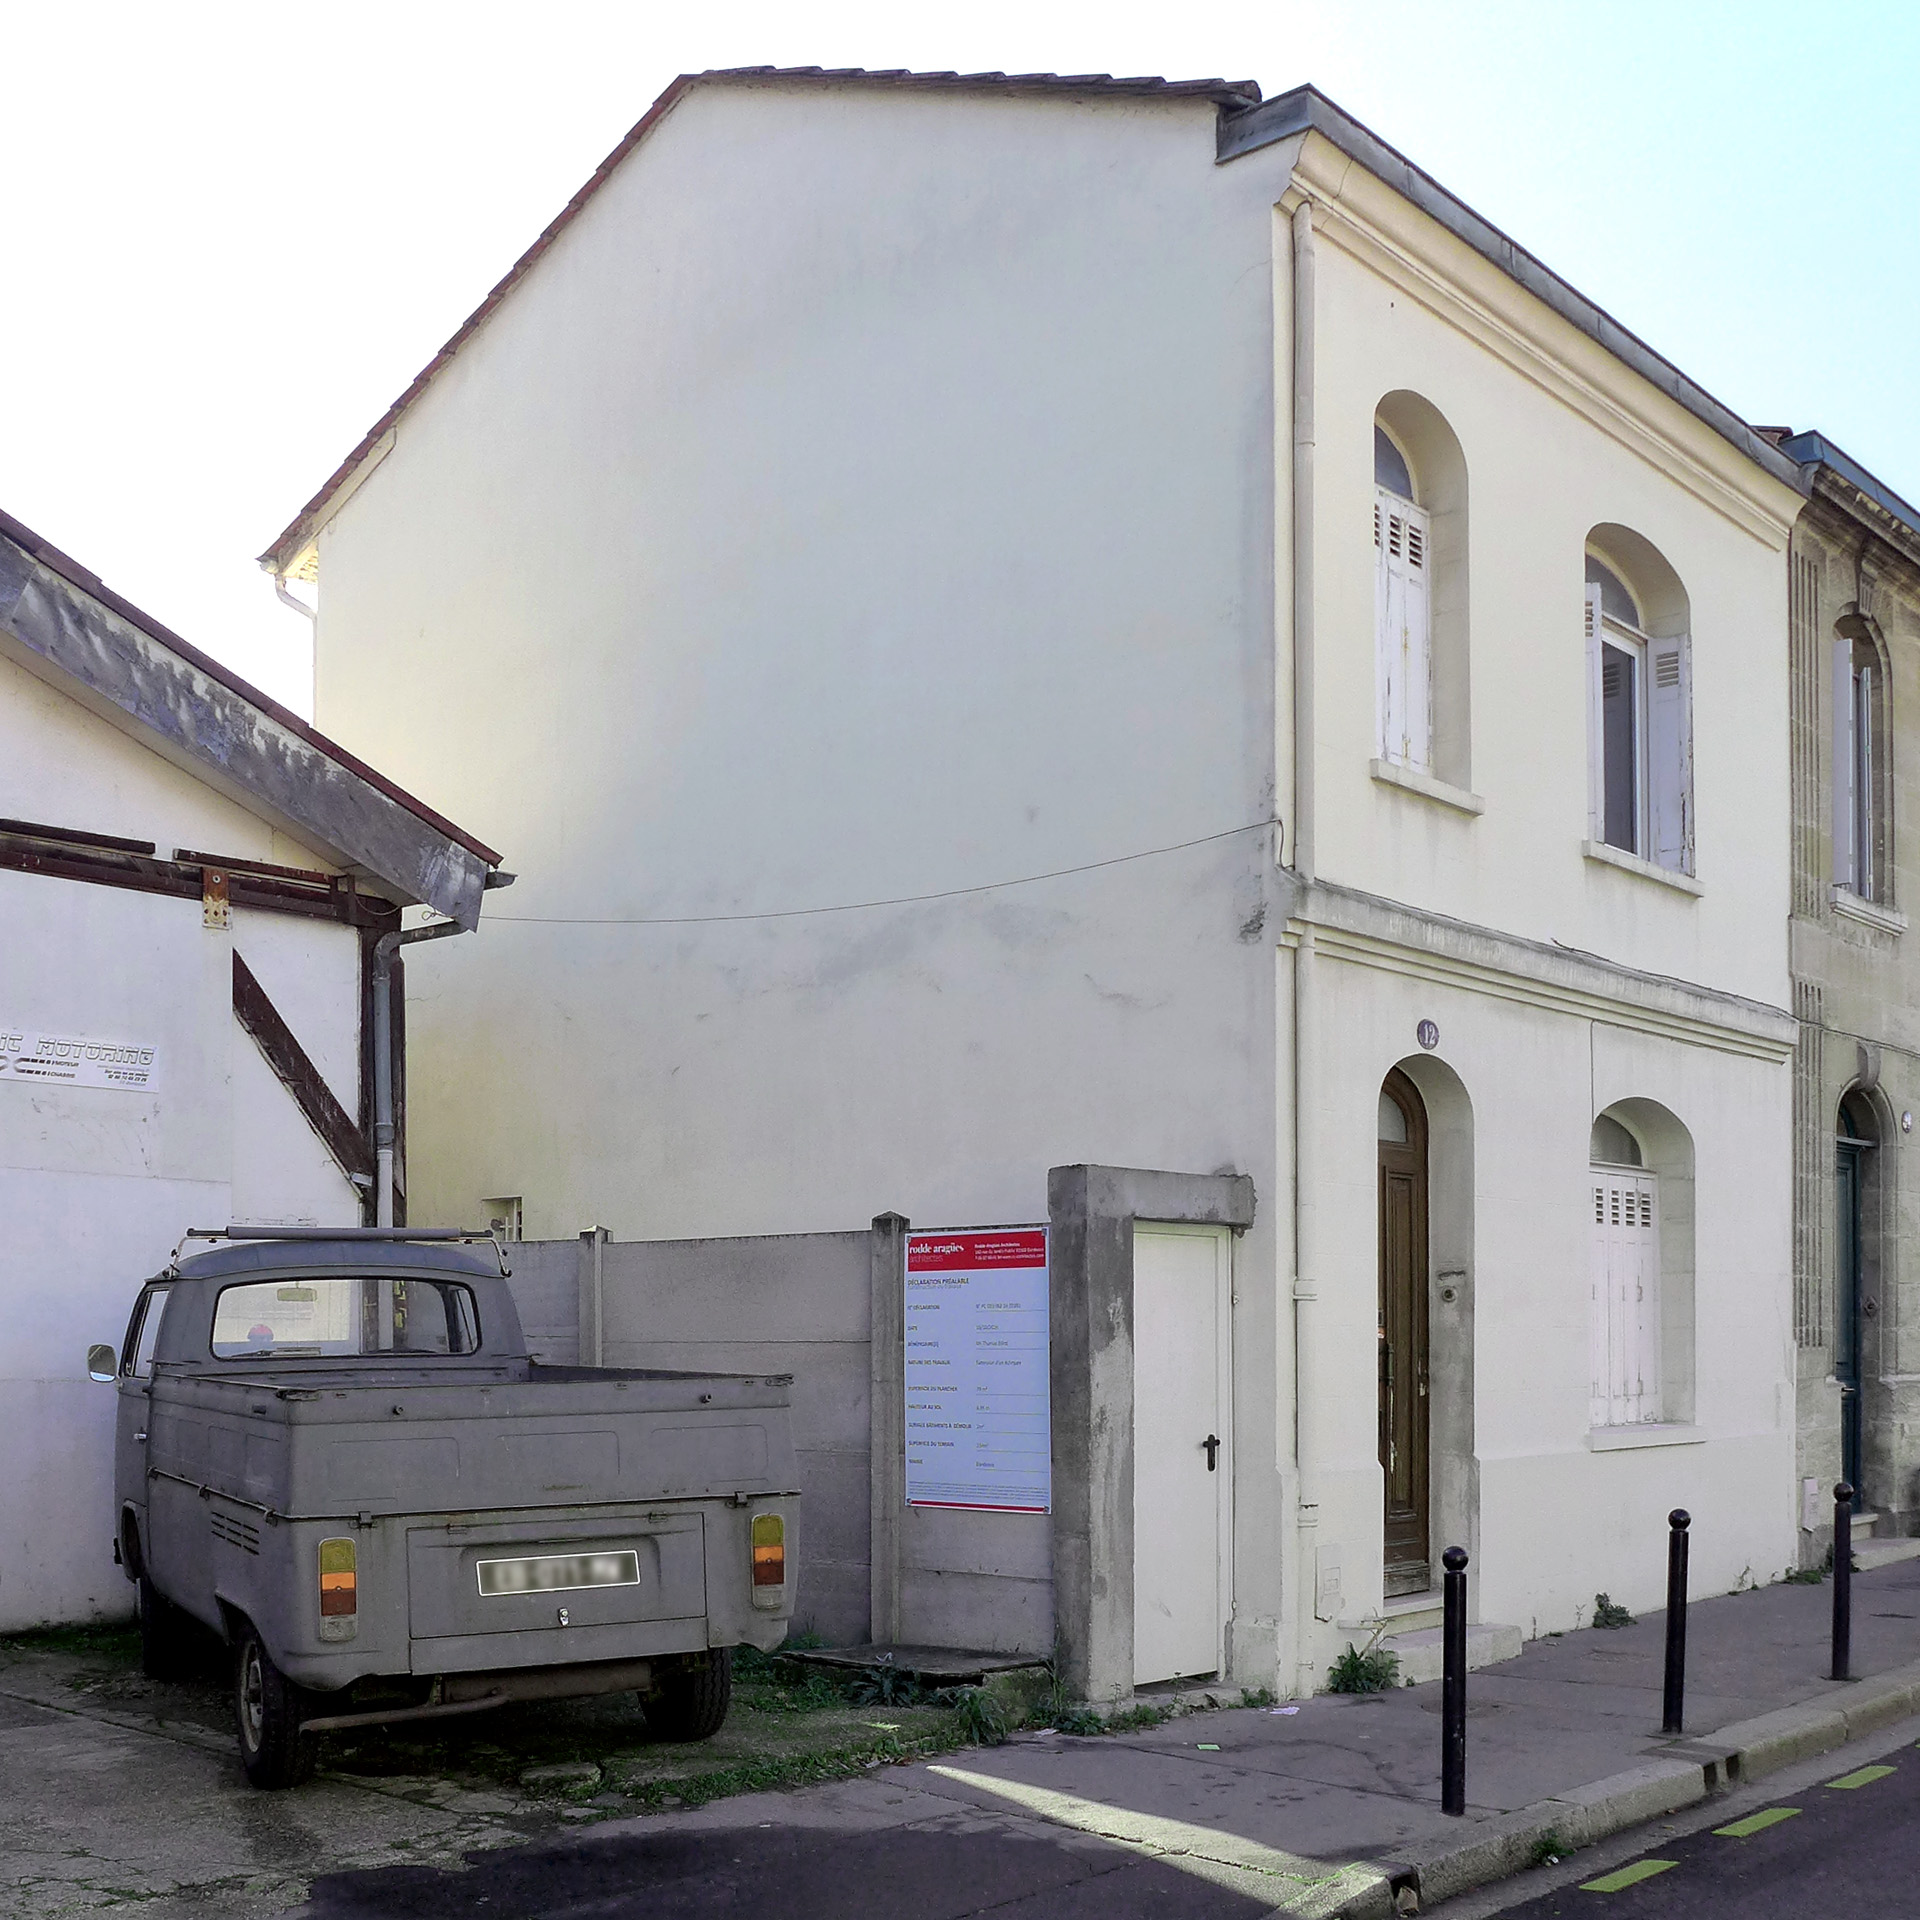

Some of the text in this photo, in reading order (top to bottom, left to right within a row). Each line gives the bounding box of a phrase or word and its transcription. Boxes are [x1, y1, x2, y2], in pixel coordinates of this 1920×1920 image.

[1424, 1024, 1435, 1044] 12
[36, 1038, 154, 1065] MOTORING
[909, 1243, 932, 1254] rodde
